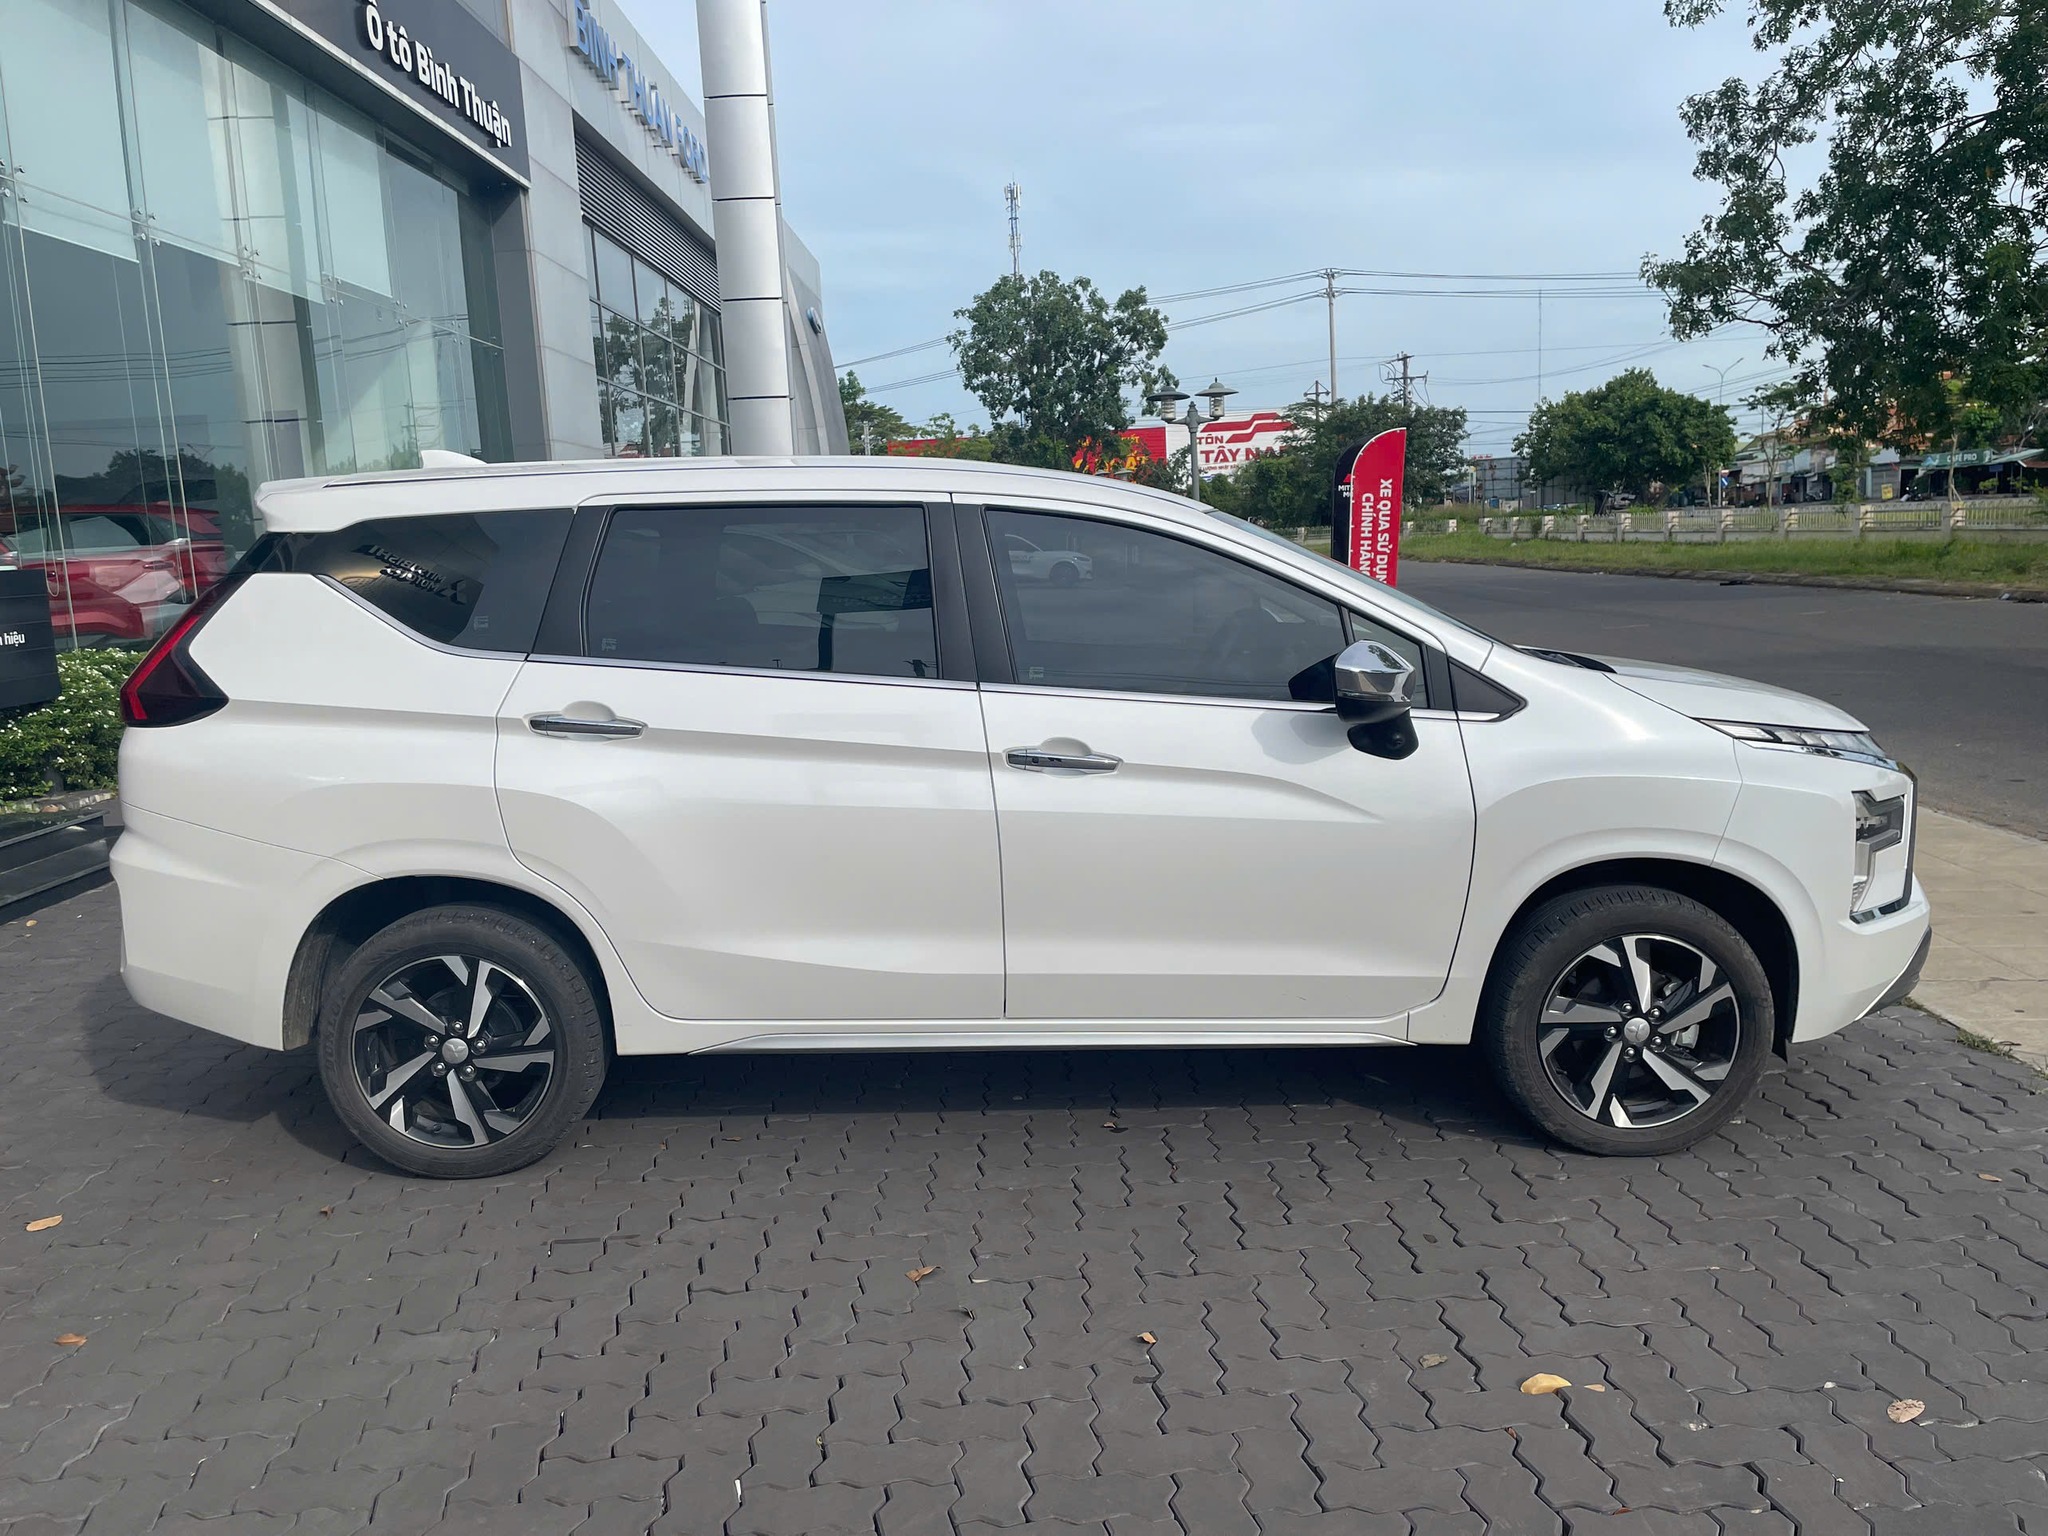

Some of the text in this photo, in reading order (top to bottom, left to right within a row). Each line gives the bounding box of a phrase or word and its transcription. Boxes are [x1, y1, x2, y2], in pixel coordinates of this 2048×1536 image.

[366, 0, 512, 148] Ô tô Bình Thuận
[673, 113, 708, 184] FORD
[1197, 433, 1224, 445] TÔN
[1200, 445, 1241, 463] TÂY
[1361, 493, 1377, 538] CHÍNH
[1373, 478, 1393, 584] XE QUA SỬ DỤN
[4, 631, 26, 647] hiệu
